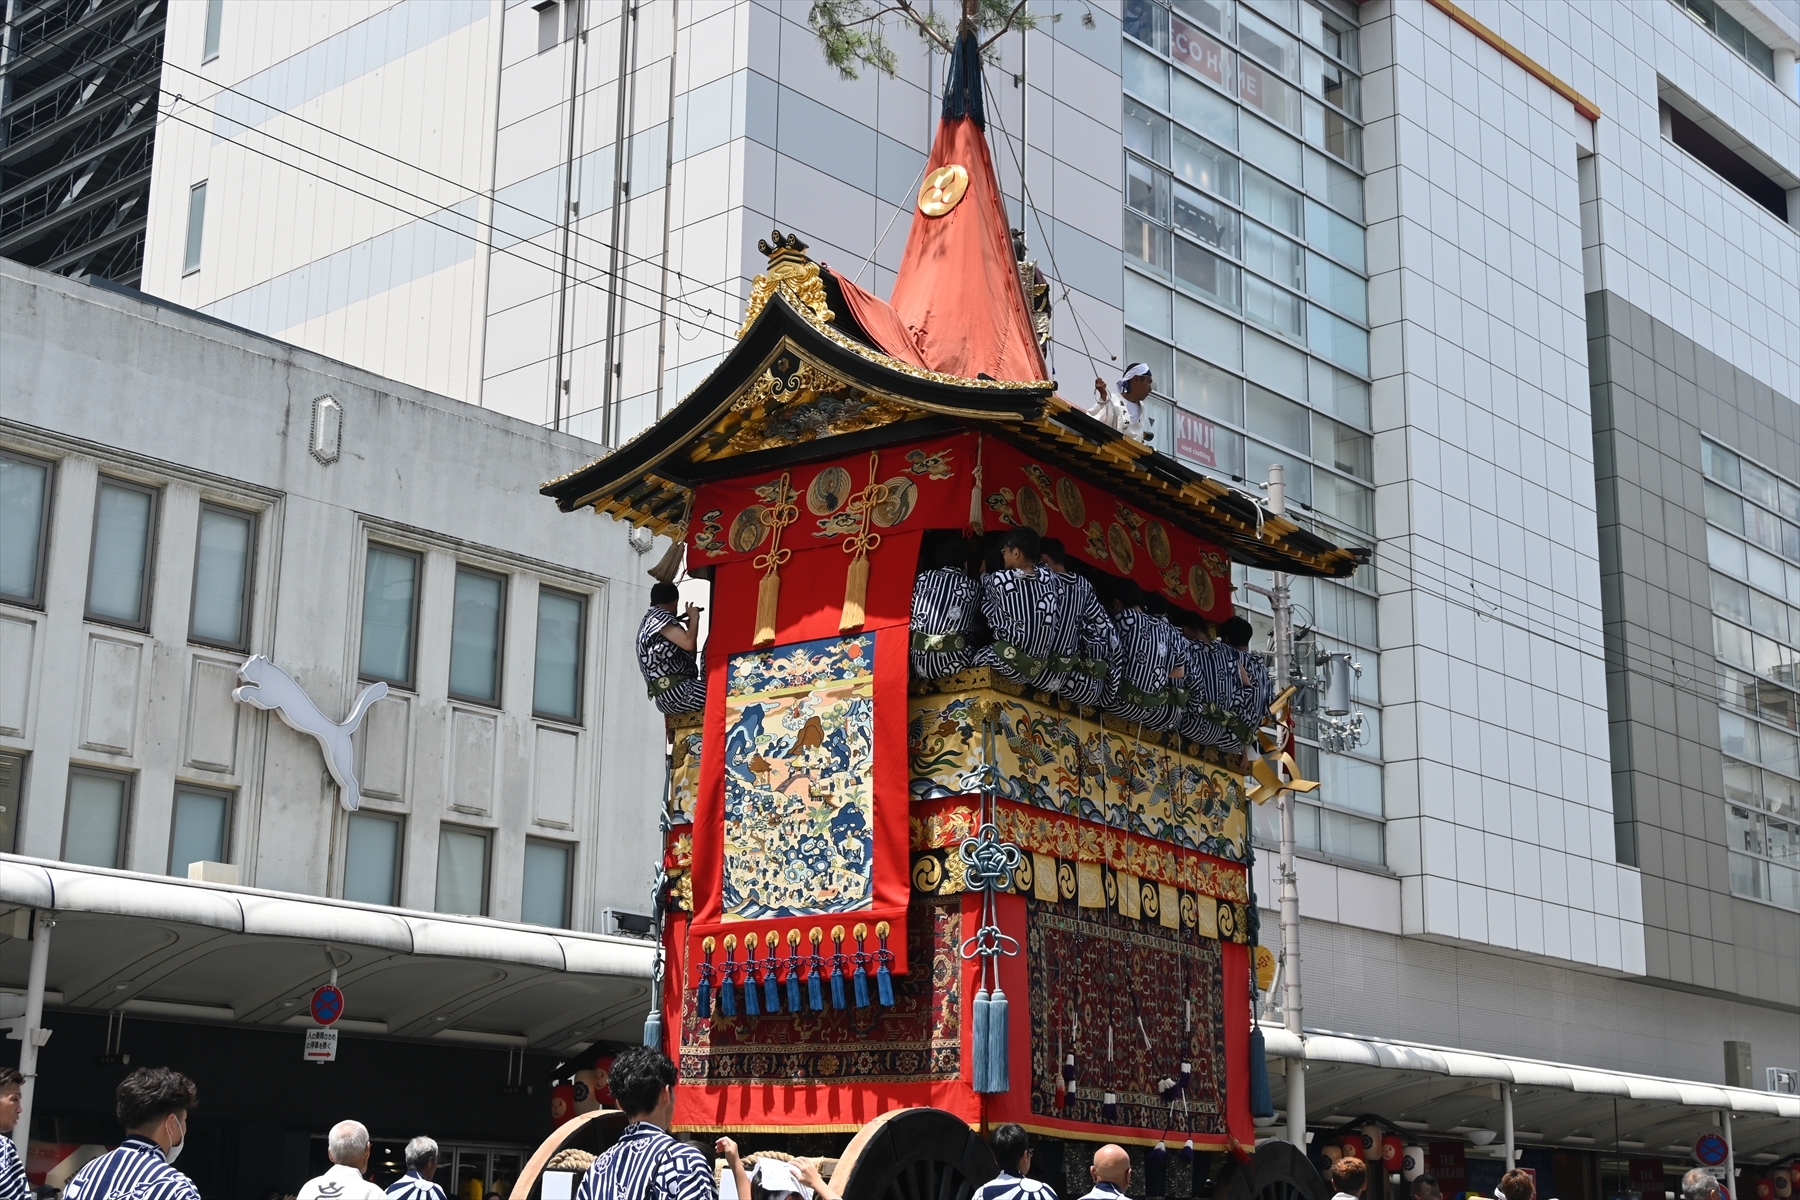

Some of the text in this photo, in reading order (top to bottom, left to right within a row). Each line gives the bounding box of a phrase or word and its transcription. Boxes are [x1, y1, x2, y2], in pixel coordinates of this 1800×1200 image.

[1176, 413, 1214, 453] KINJI
[1181, 444, 1211, 463] used clothing
[1439, 1154, 1455, 1166] THE
[1430, 1167, 1465, 1179] BARGAIN
[1639, 1170, 1655, 1180] THE
